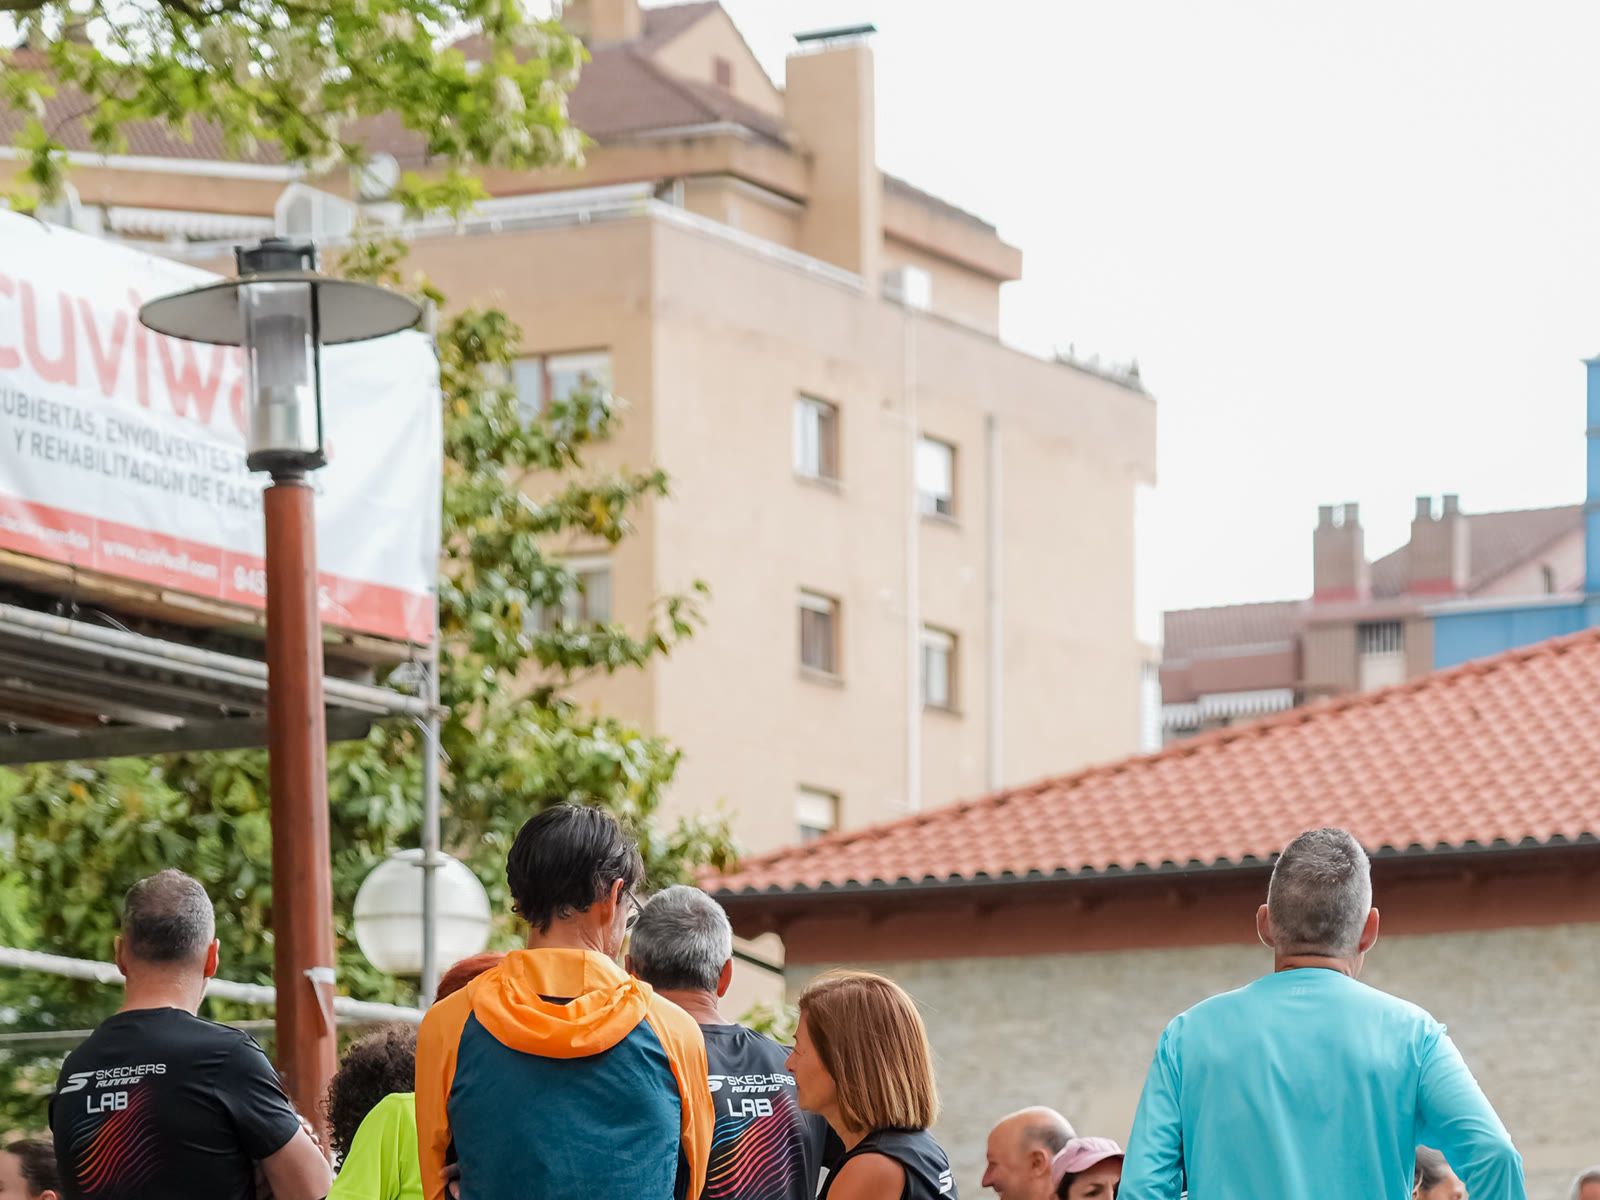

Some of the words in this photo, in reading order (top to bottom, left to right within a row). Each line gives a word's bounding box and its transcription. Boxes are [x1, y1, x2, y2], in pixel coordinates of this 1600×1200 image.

[0, 388, 100, 441] UBIERTAS,
[13, 427, 25, 453] Y
[188, 472, 210, 499] DE
[95, 1063, 167, 1080] SKECHERS
[726, 1073, 796, 1086] SKECHERS
[87, 1091, 128, 1114] LAB
[727, 1098, 774, 1117] LAB
